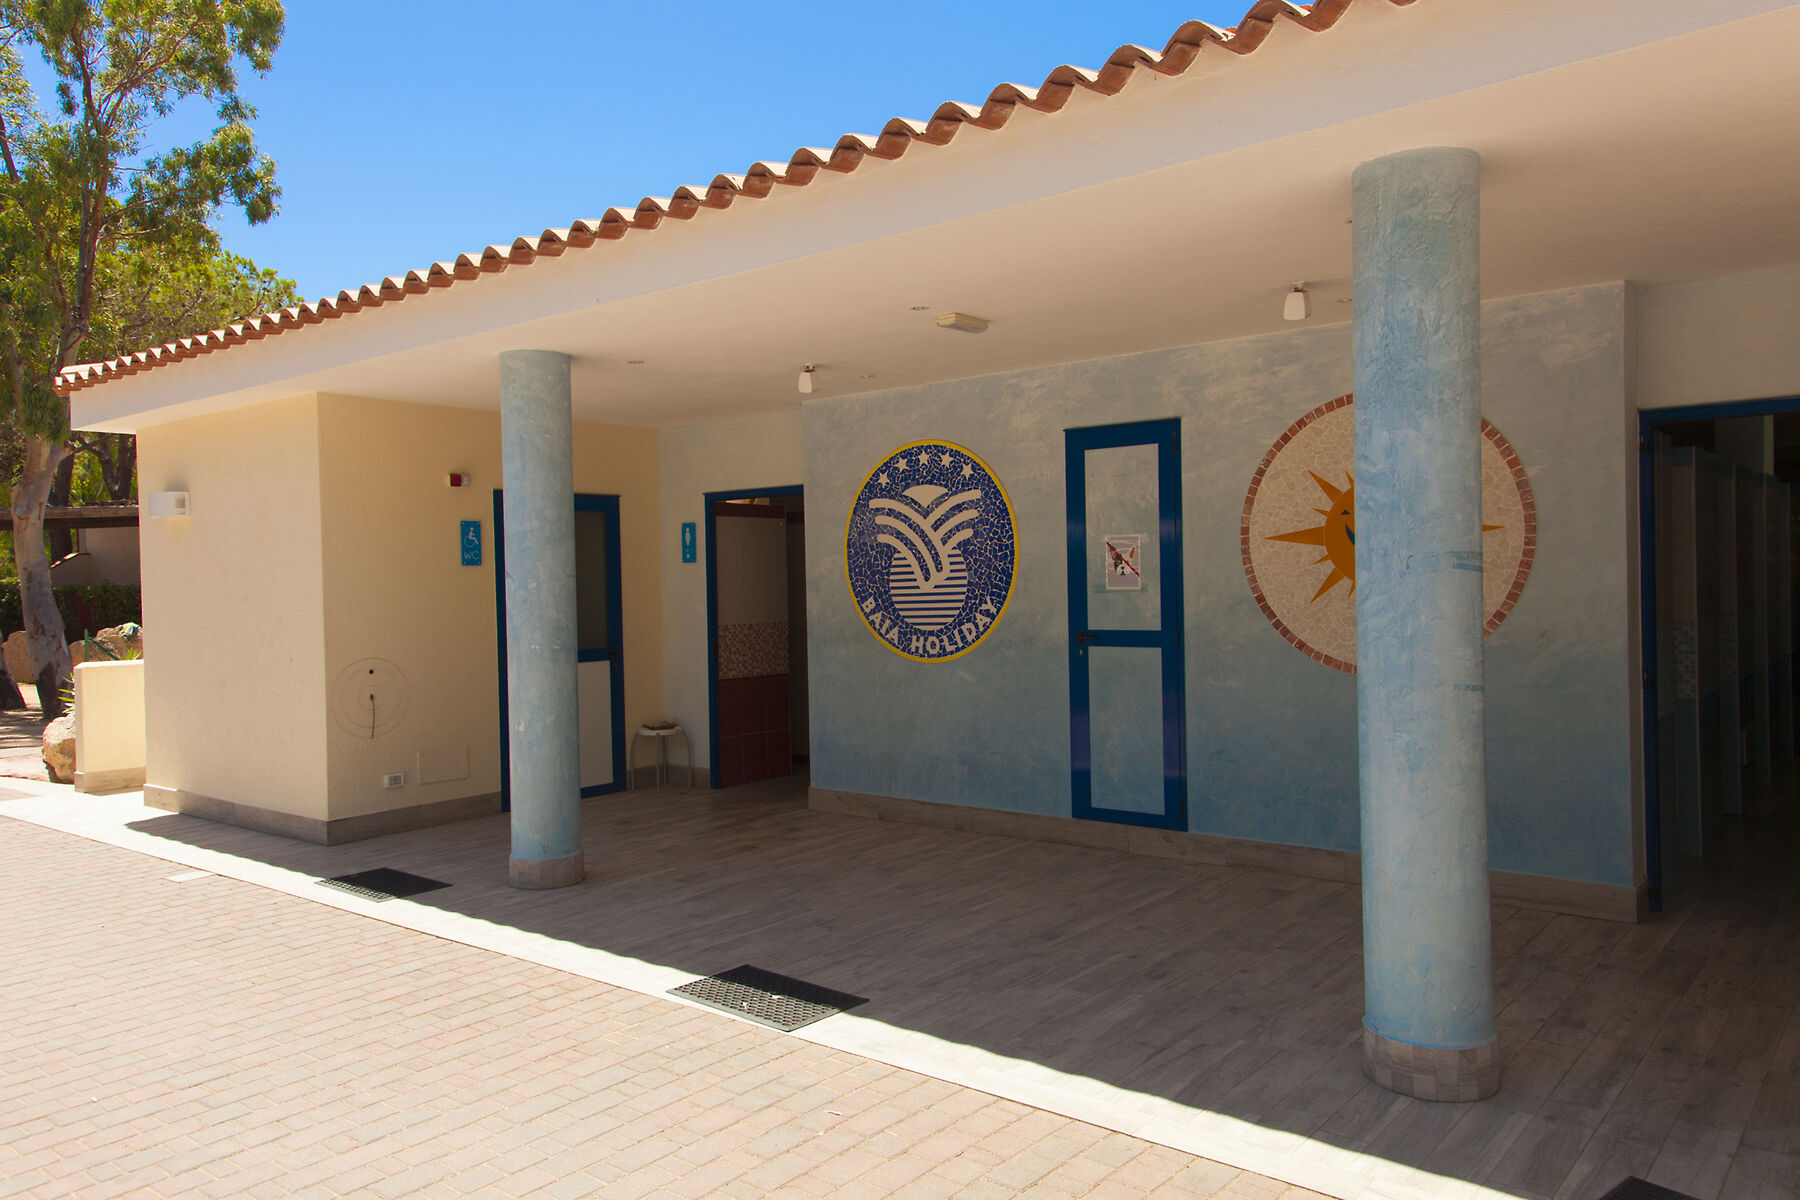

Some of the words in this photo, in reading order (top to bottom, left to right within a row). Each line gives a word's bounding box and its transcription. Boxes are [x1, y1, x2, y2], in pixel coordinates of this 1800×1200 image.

[463, 550, 480, 560] WC
[862, 597, 901, 646] BAIA
[911, 596, 997, 655] HOLIDAY
